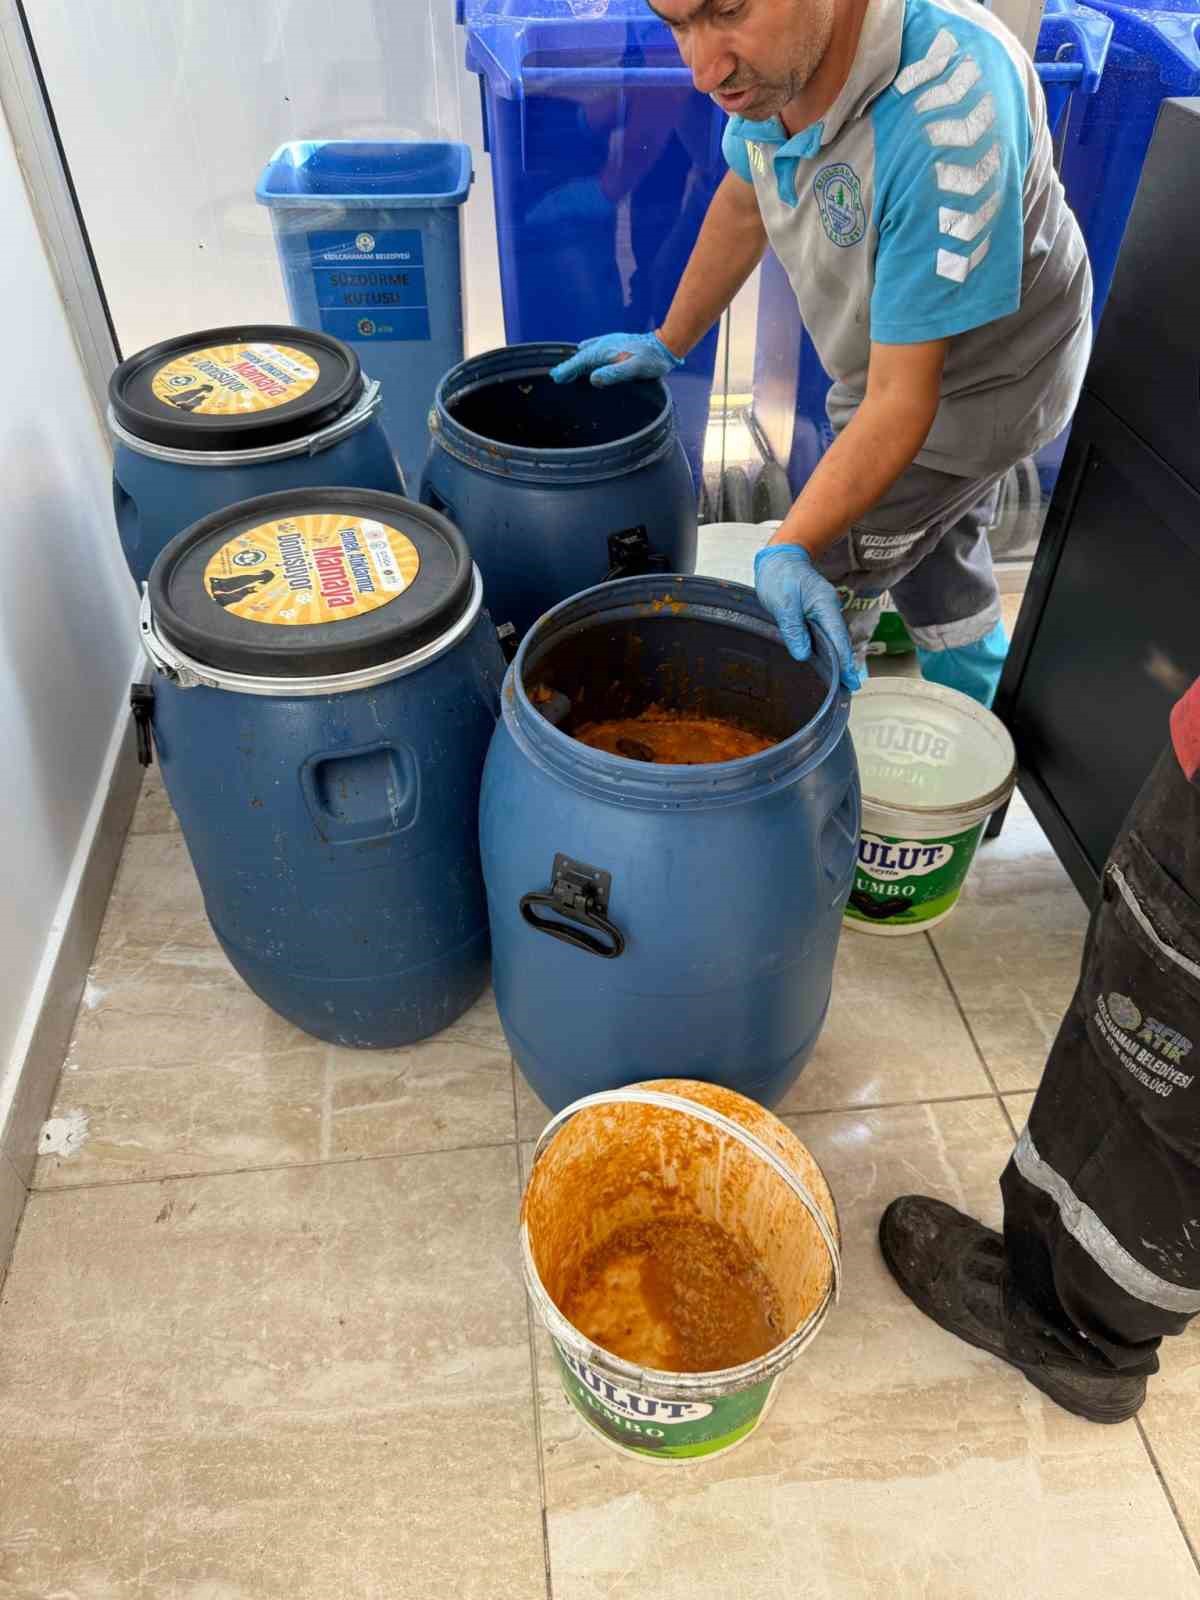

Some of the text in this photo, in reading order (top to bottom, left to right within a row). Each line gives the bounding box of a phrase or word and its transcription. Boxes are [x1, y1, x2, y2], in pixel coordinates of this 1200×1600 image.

[329, 272, 409, 287] SÜZDÜRME
[344, 292, 400, 305] KUTUSU
[276, 532, 314, 591] Dönüşüyor
[312, 545, 355, 609] Mamaya
[857, 839, 943, 871] ULUT
[857, 877, 916, 896] UMBO
[1135, 1047, 1196, 1089] BELEDİYESİ
[577, 1386, 665, 1438] JUMBO
